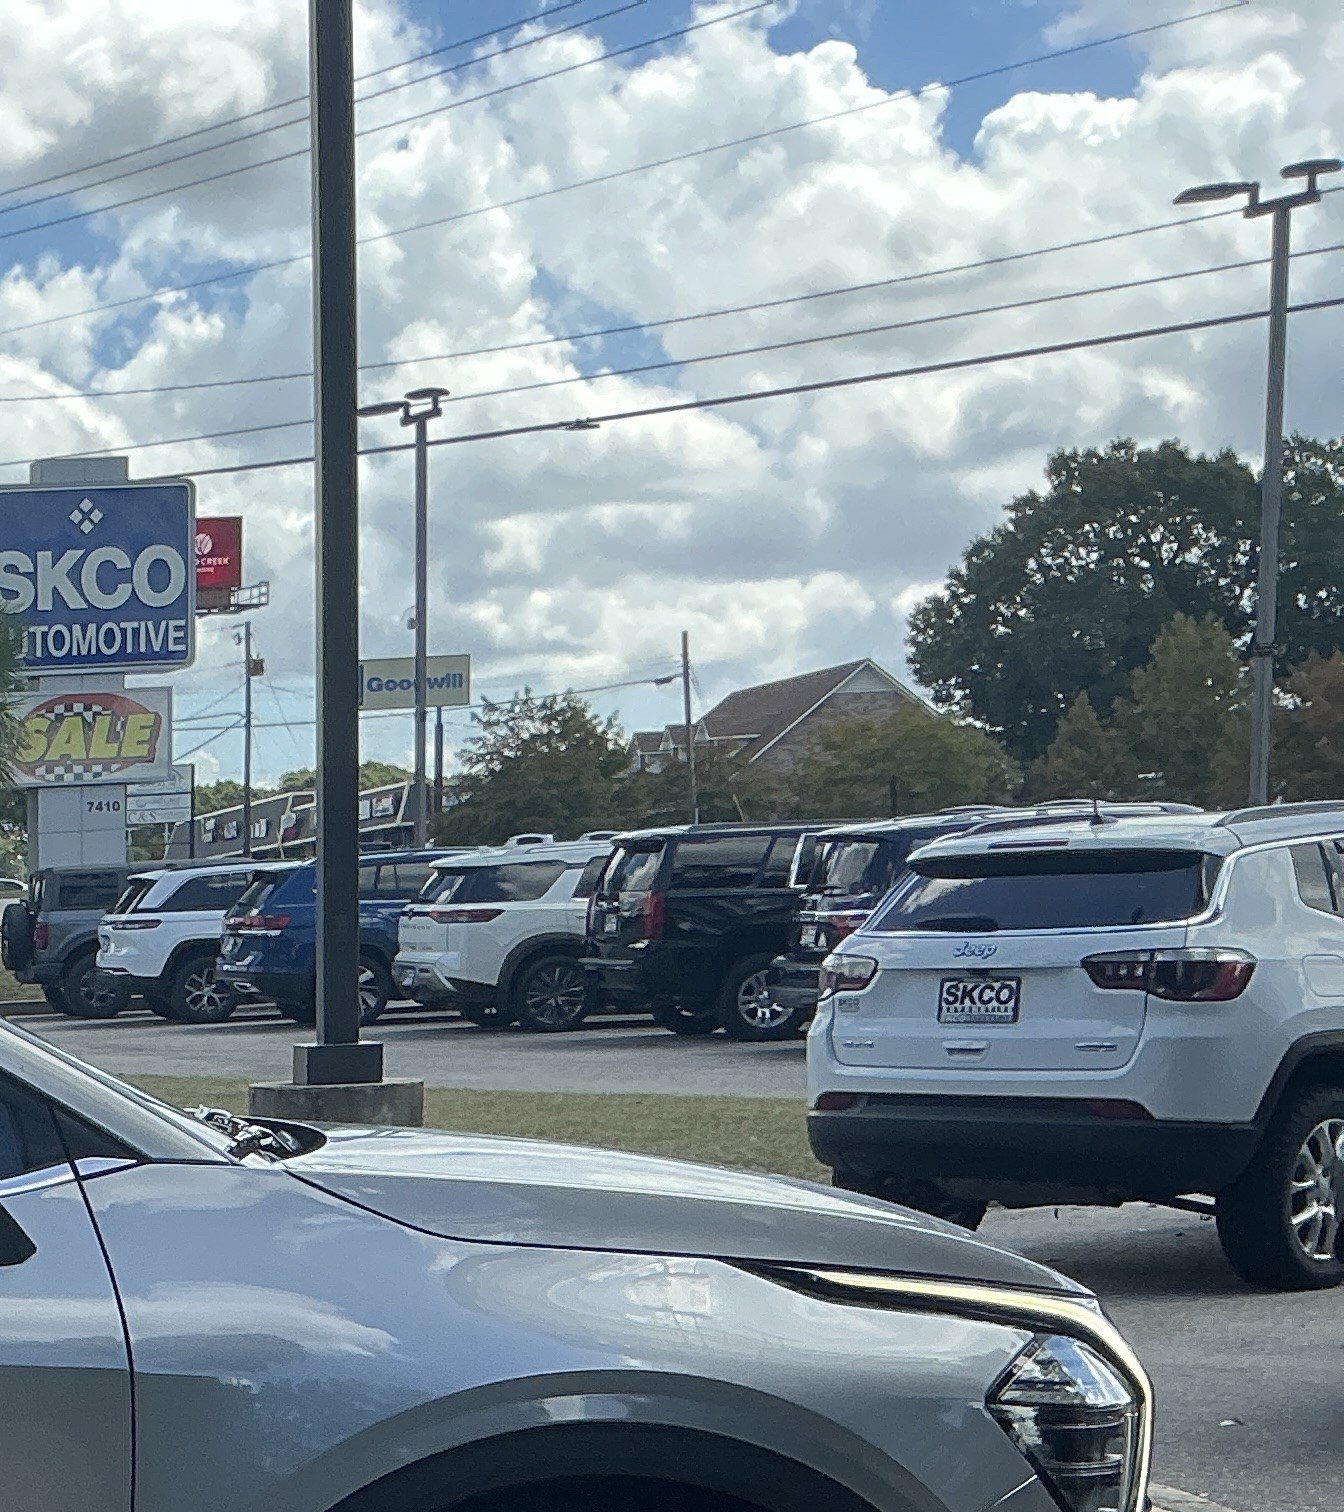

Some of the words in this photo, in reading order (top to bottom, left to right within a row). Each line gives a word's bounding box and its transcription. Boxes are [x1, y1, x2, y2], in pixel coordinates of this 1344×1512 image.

[367, 673, 463, 692] Goowill
[14, 713, 156, 763] SALE
[86, 801, 121, 813] 7410
[953, 941, 998, 959] Jeep
[943, 983, 1015, 1006] SKCO
